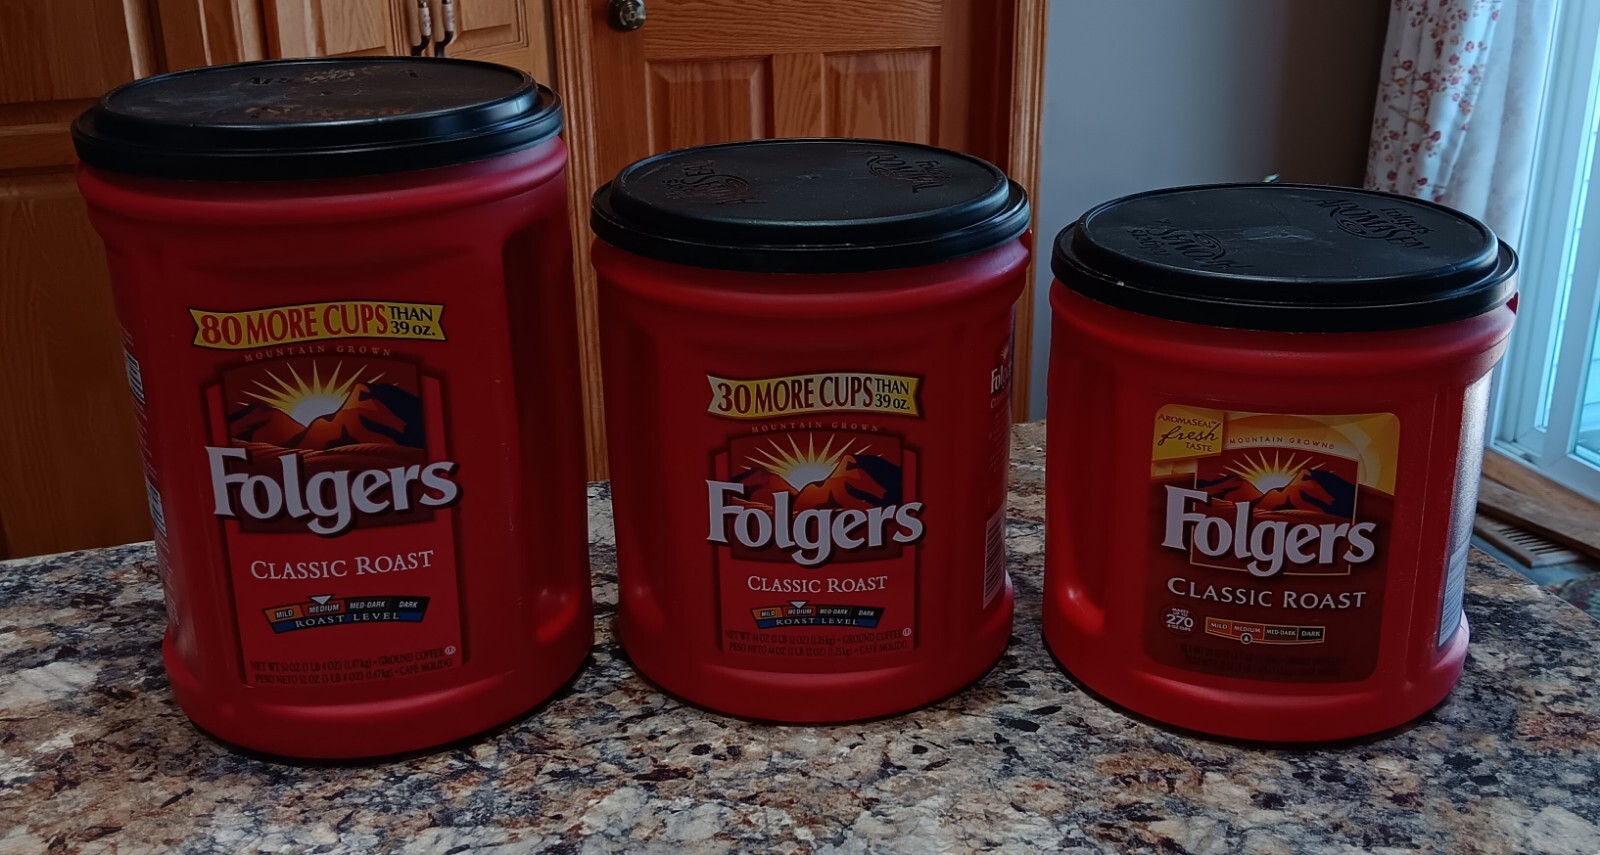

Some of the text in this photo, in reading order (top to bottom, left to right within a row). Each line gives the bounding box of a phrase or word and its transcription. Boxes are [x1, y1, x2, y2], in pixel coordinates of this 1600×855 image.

[200, 304, 433, 346] 80 MORE CUPS THAN
[390, 321, 436, 336] 39 oz.
[244, 344, 392, 362] MOUNTAIN GROWN
[717, 376, 910, 414] 30 MORE CUPS THAN
[875, 393, 910, 410] 39 oz.
[751, 421, 880, 434] MOUNTAIN GROWN
[1157, 423, 1221, 446] fresh
[1185, 442, 1212, 452] TASTE
[1229, 435, 1284, 445] MOUNTAIN
[204, 446, 461, 536] Folgers
[705, 479, 924, 566] Folgers
[1161, 485, 1377, 577] Folgers
[250, 550, 435, 580] CLASSIC ROAST
[747, 576, 888, 593] CLASSIC ROAST
[1167, 577, 1367, 609] CLASSIC ROAST
[275, 600, 419, 619] MILD MEDIUM MED-DARK DARK
[761, 609, 776, 617] MILD
[858, 609, 875, 617] DARK
[295, 611, 400, 628] ROAST LEVEL
[775, 617, 859, 626] ROAST LEVEL
[1166, 613, 1194, 628] 270
[1210, 622, 1228, 630] MILD
[1233, 625, 1261, 633] MEDIUM
[1266, 628, 1297, 636] MED-DARK
[842, 632, 875, 645] GROUND
[378, 653, 414, 665] GROUND
[415, 647, 445, 660] COFFEE
